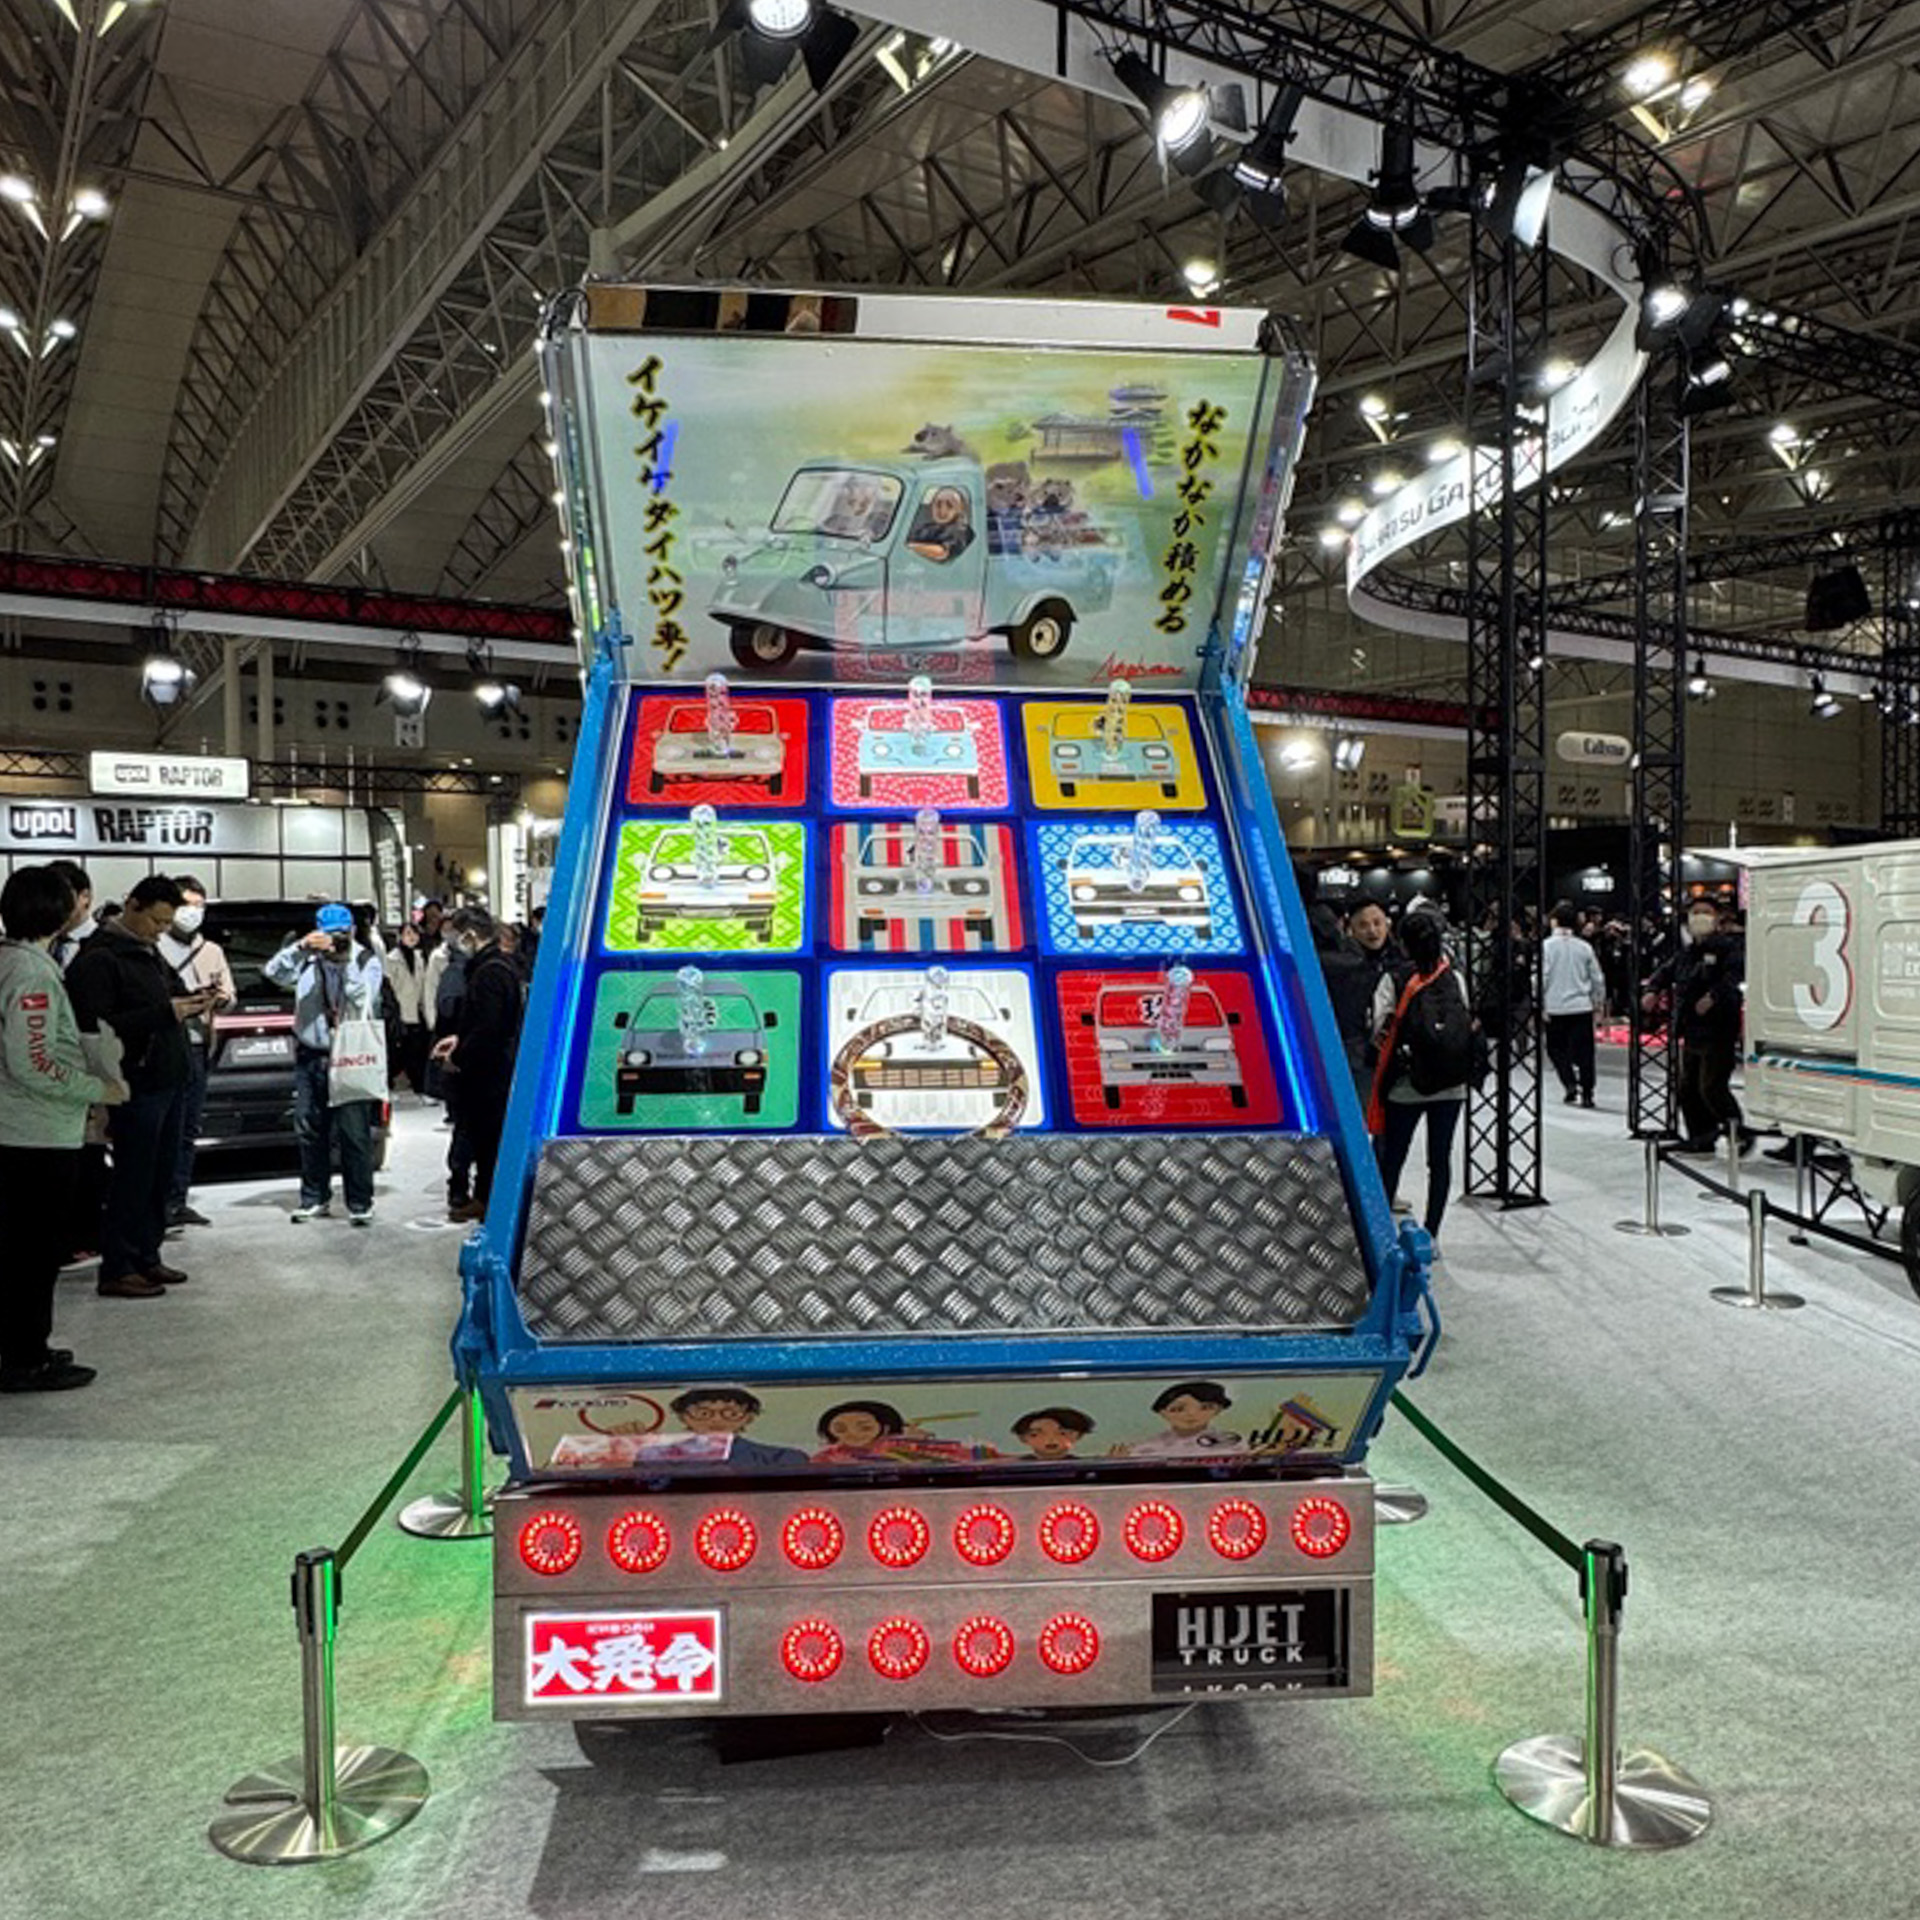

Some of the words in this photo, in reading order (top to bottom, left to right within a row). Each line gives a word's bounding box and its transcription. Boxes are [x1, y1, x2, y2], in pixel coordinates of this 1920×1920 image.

[1154, 399, 1228, 635] なかなか積める
[159, 766, 223, 788] RAPTOR
[94, 807, 214, 844] RAPTOR
[1792, 877, 1853, 1031] 3
[1177, 1604, 1305, 1648] HIJET
[533, 1633, 716, 1692] 大発令
[1180, 1646, 1303, 1665] TRUCK
